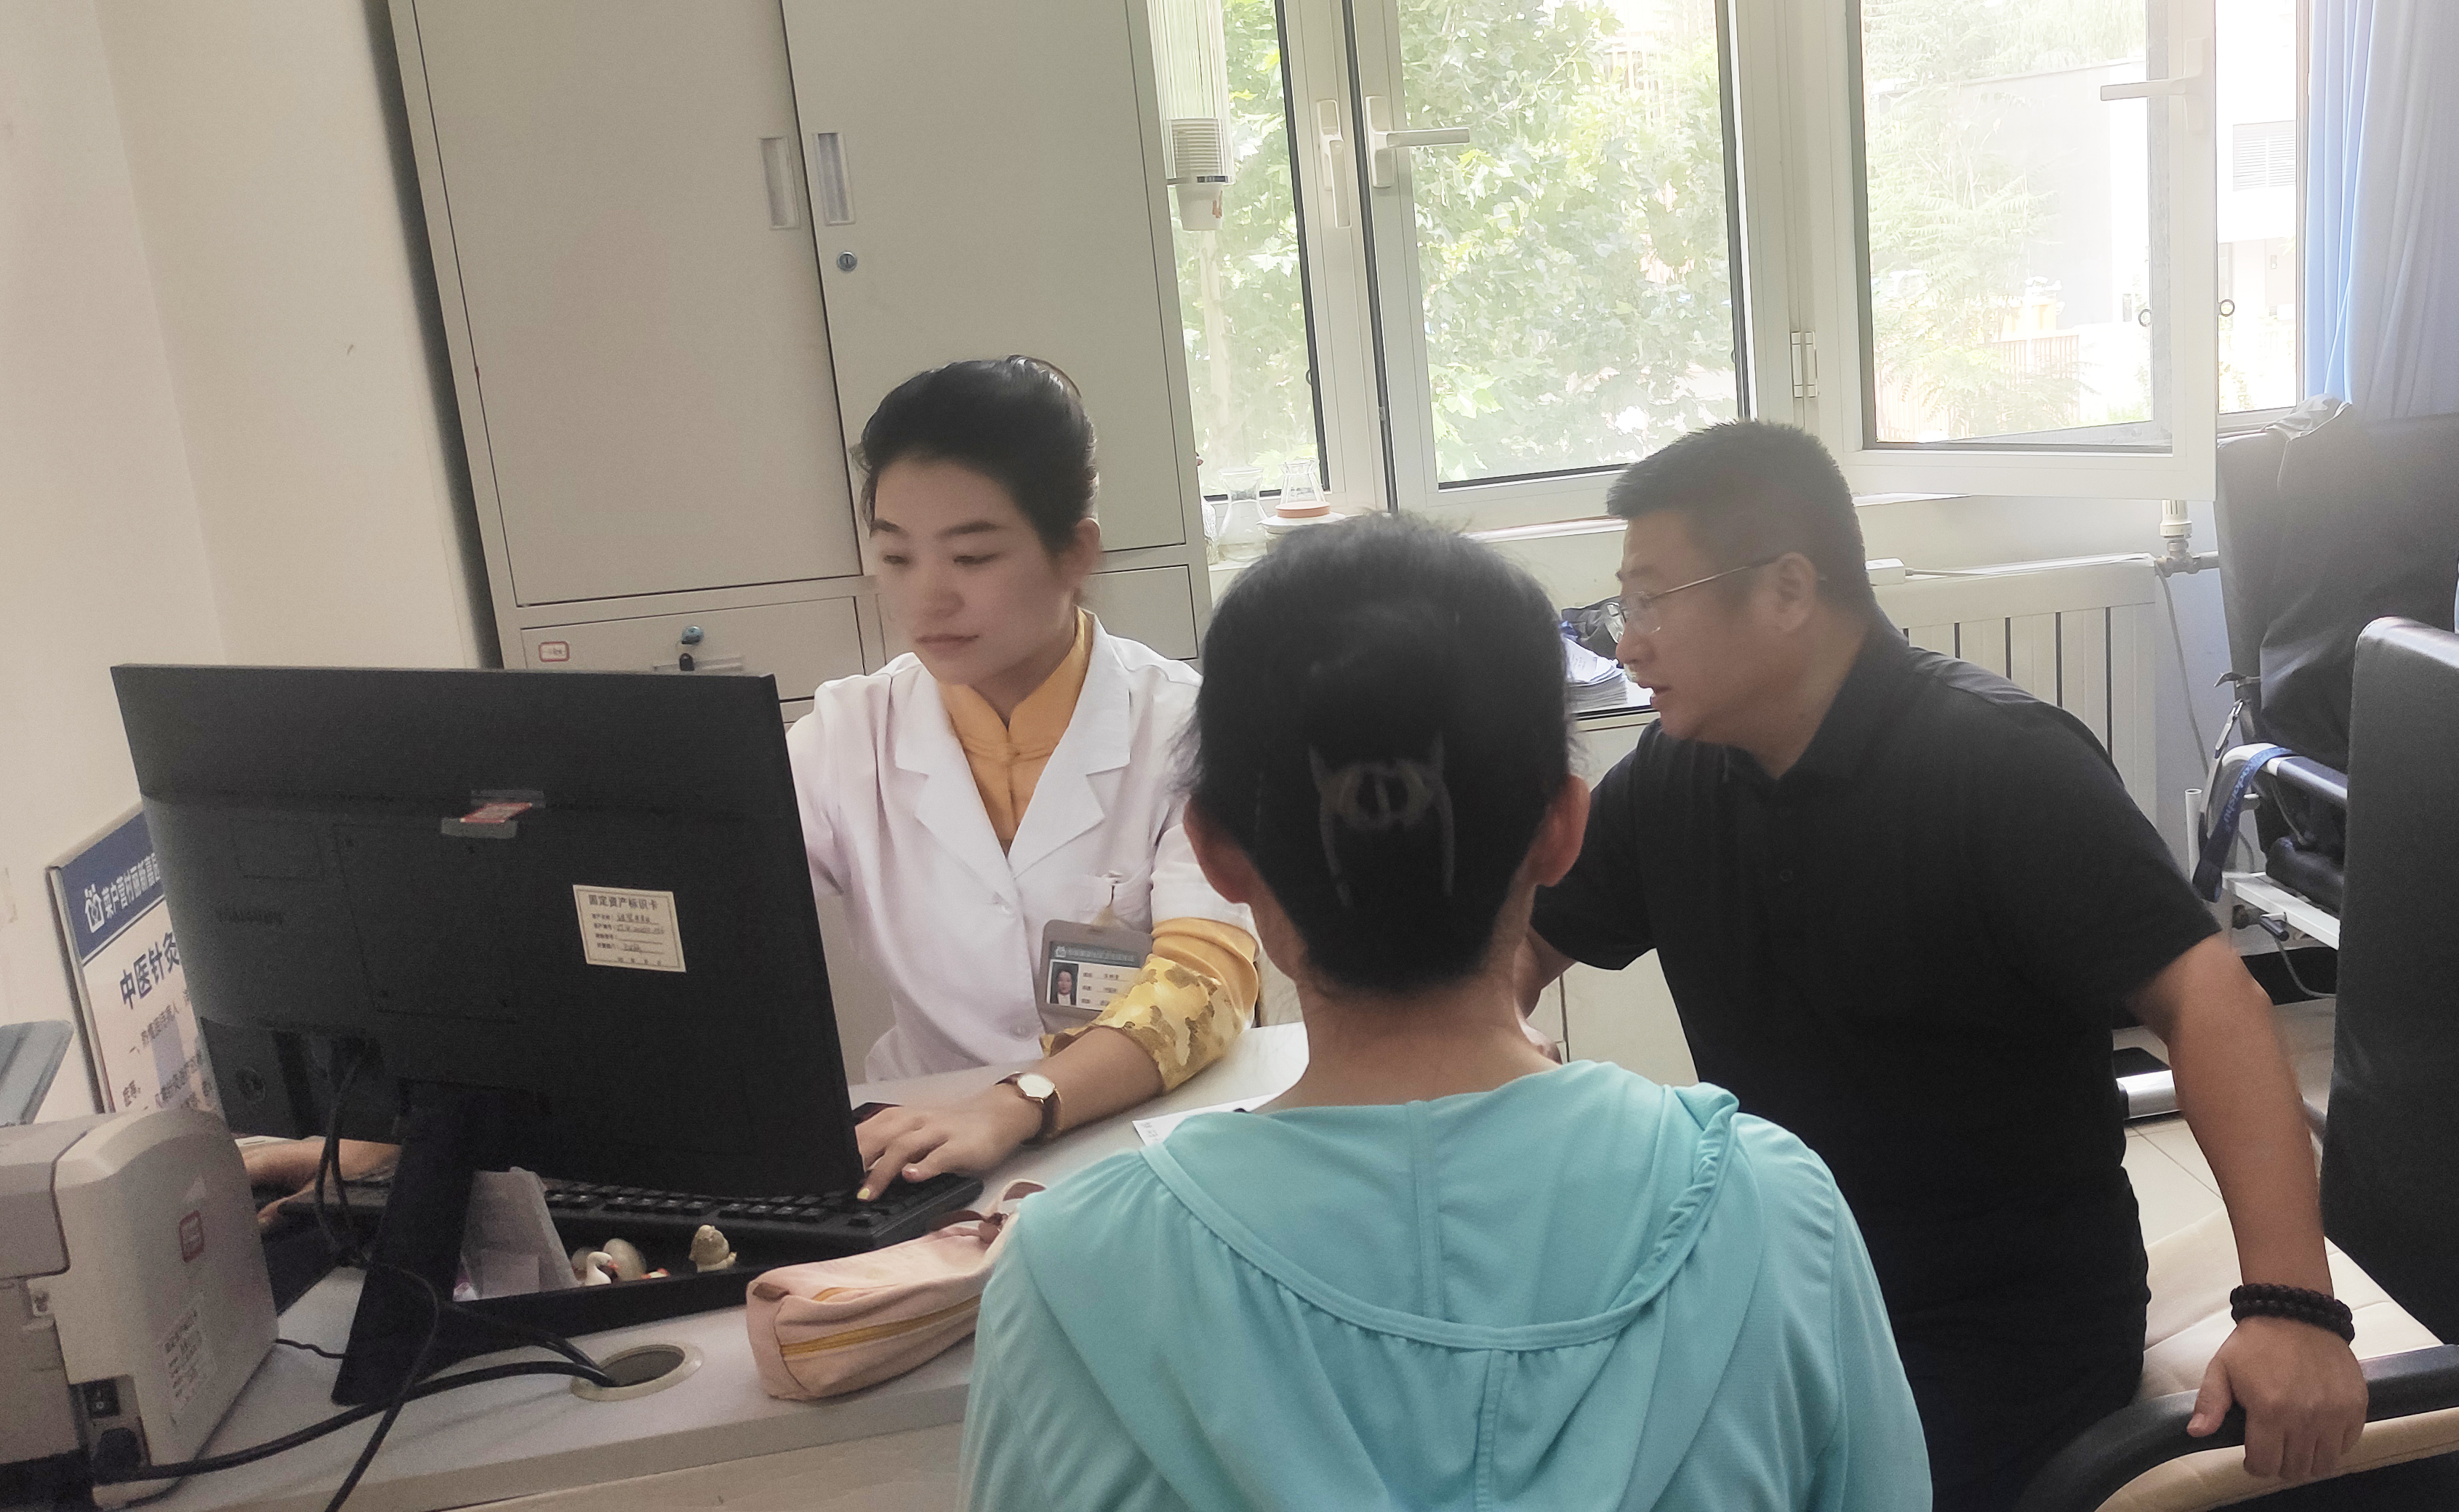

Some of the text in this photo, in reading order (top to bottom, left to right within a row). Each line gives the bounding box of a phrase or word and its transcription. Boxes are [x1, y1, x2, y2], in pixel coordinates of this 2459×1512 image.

[588, 895, 659, 910] 固定资产标识卡
[119, 930, 180, 1010] 中医针灸
